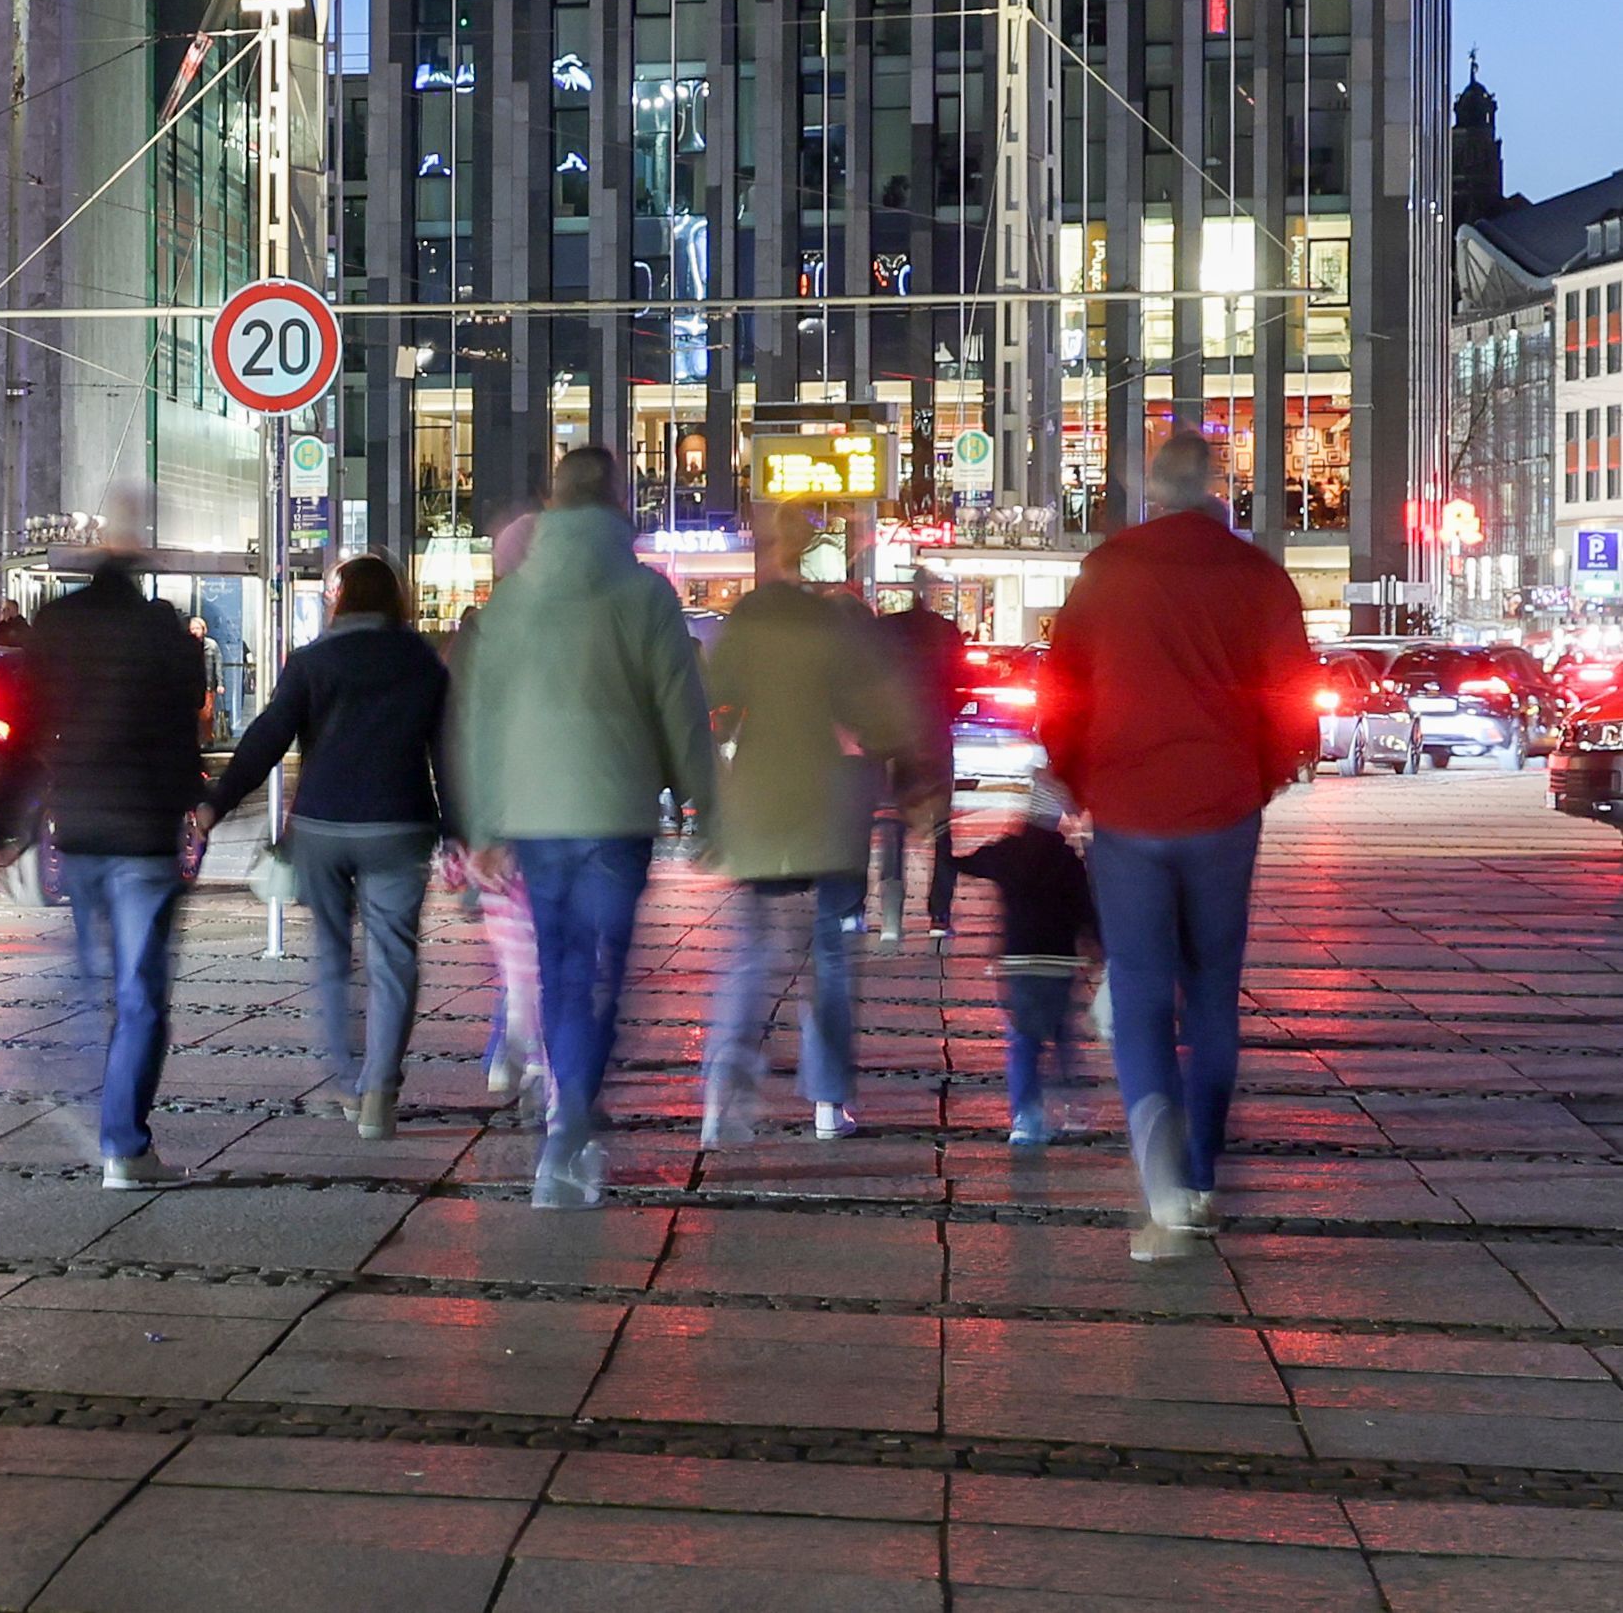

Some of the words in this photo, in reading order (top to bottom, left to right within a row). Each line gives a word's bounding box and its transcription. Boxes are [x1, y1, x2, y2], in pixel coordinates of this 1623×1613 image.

[242, 318, 310, 376] 20
[655, 530, 727, 553] PASTA
[1589, 539, 1605, 561] P
